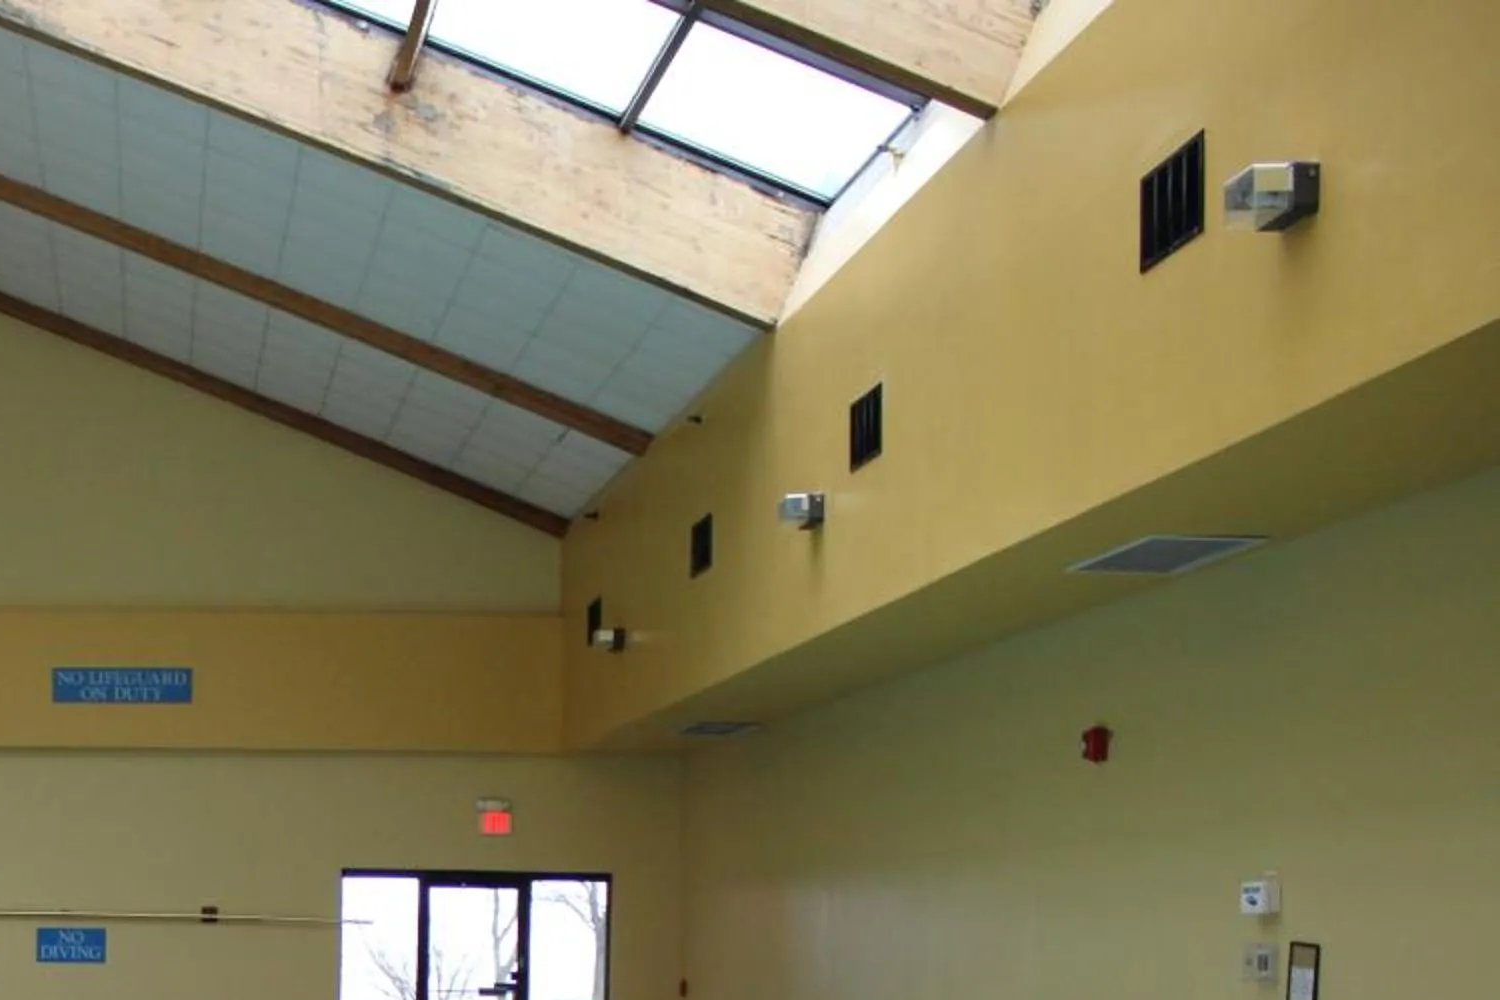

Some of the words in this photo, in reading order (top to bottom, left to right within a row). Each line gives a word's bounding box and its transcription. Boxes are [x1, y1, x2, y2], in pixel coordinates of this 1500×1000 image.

[58, 671, 84, 685] NO
[90, 671, 187, 686] LIFEGUARD
[80, 686, 106, 700] ON
[114, 686, 161, 701] DUTY
[58, 930, 85, 945] NO
[41, 945, 101, 959] DIVING
